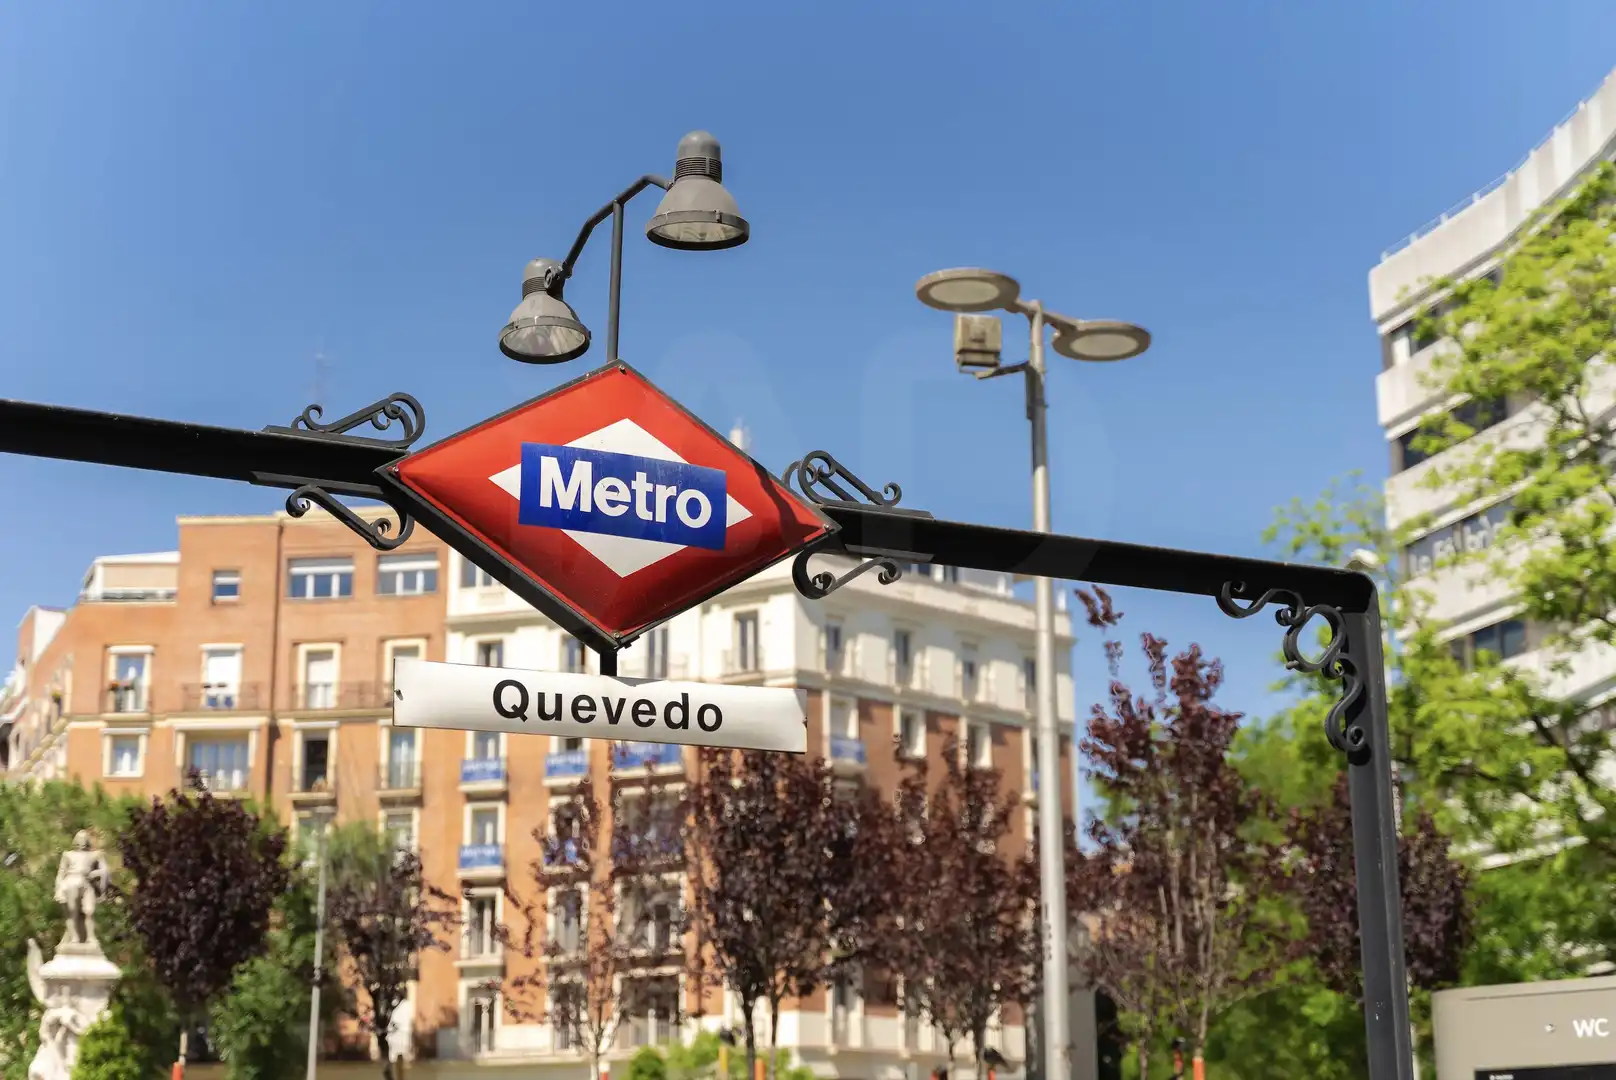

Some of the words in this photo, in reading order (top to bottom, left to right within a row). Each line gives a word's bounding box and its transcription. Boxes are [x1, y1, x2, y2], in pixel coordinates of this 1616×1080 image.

[539, 455, 712, 529] Metro
[492, 679, 723, 733] Quevedo
[1573, 1018, 1610, 1038] WC
